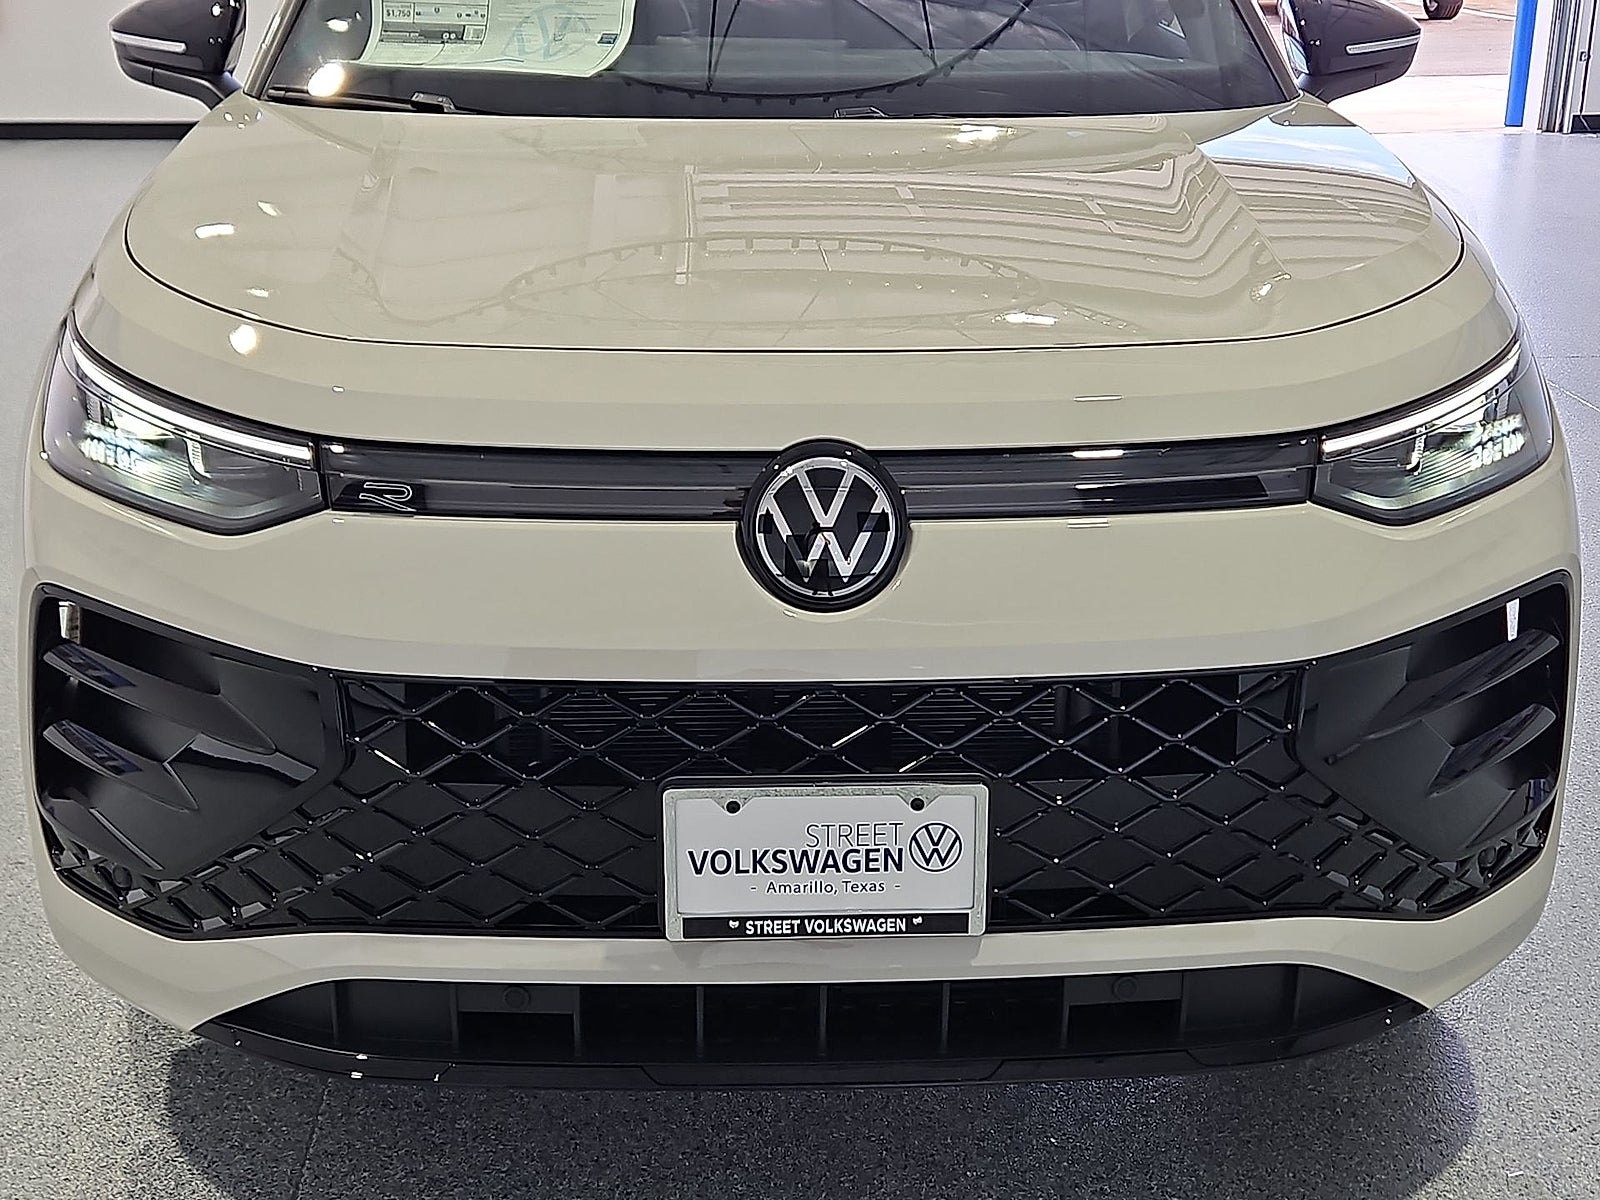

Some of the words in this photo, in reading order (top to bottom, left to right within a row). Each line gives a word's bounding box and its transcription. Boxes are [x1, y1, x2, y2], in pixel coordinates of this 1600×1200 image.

[386, 9, 411, 18] $1,750
[805, 822, 904, 848] STREET
[908, 822, 963, 872] VW
[687, 847, 904, 875] VOLKSWAGEN
[766, 880, 838, 895] Amarillo,
[842, 880, 885, 893] Texas
[745, 919, 801, 935] STREET
[804, 917, 907, 934] VOLKSWAGEN
